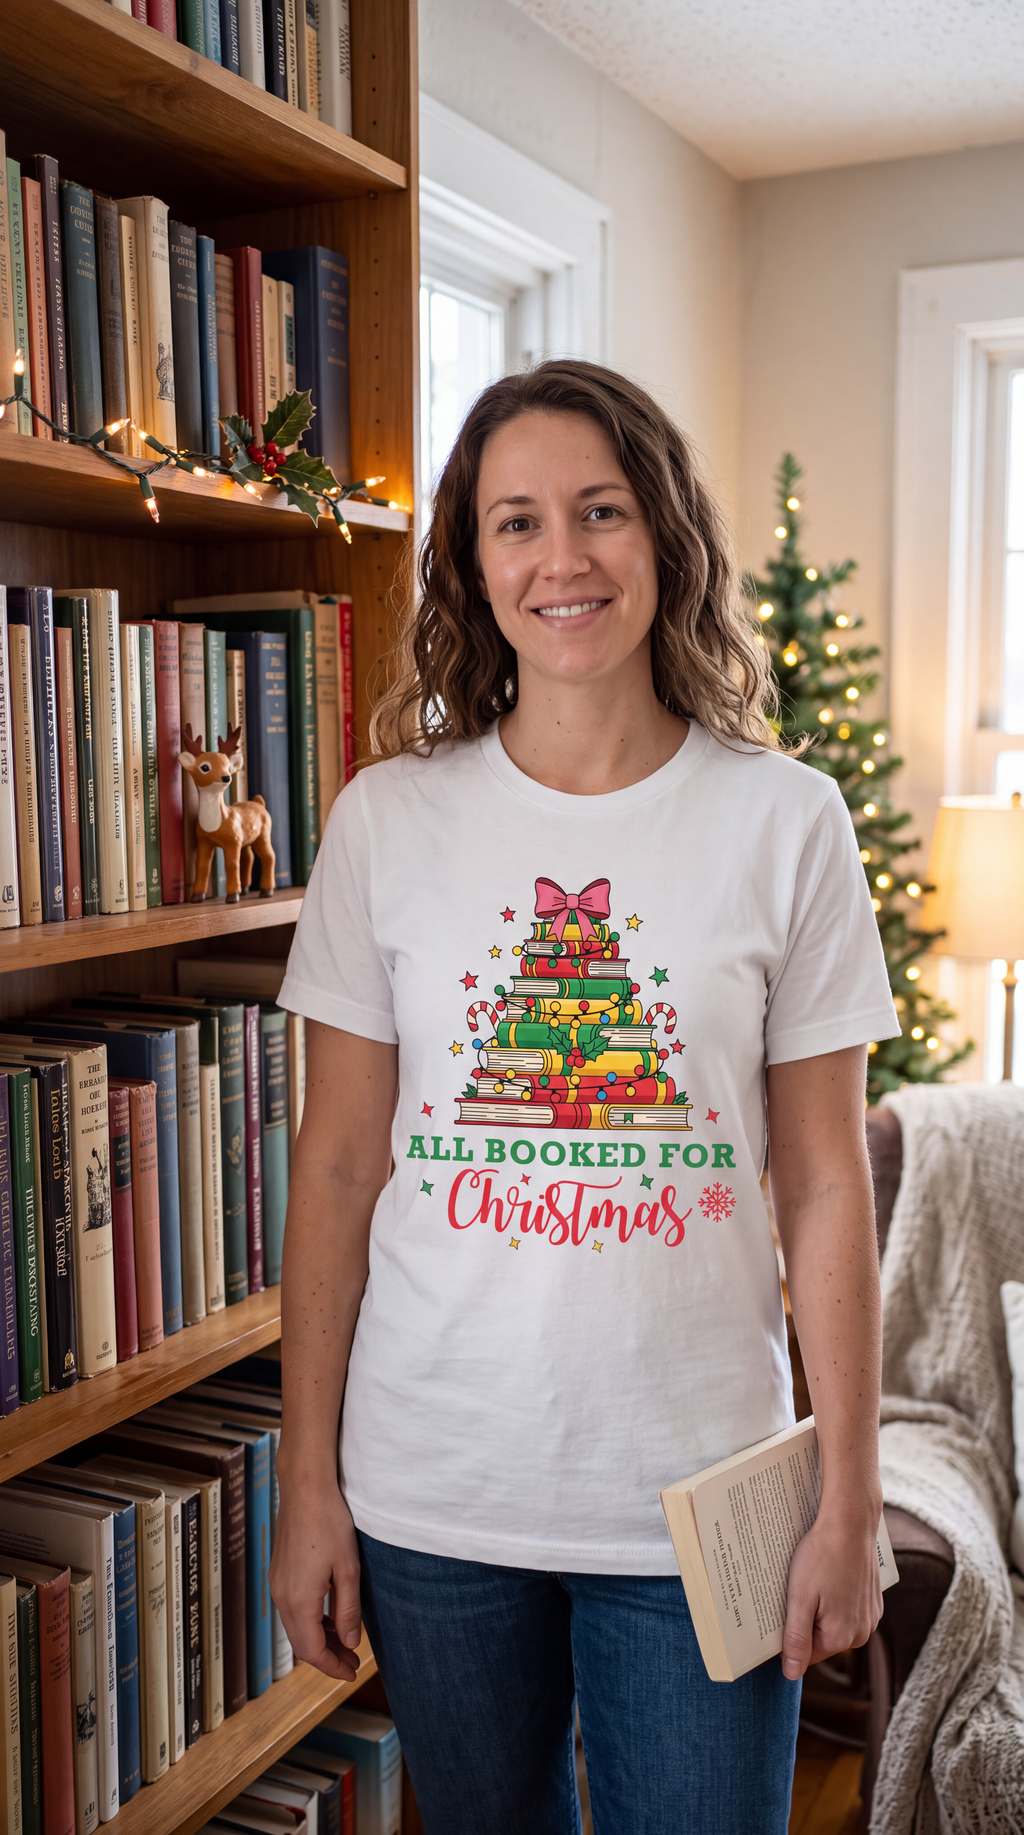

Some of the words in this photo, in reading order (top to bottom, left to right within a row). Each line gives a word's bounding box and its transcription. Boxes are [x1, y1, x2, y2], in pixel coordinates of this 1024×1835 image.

[87, 1064, 101, 1074] THE
[407, 1136, 473, 1161] ALL
[485, 1139, 645, 1167] BOOKED
[659, 1144, 736, 1168] FOR
[448, 1168, 692, 1247] Christmas
